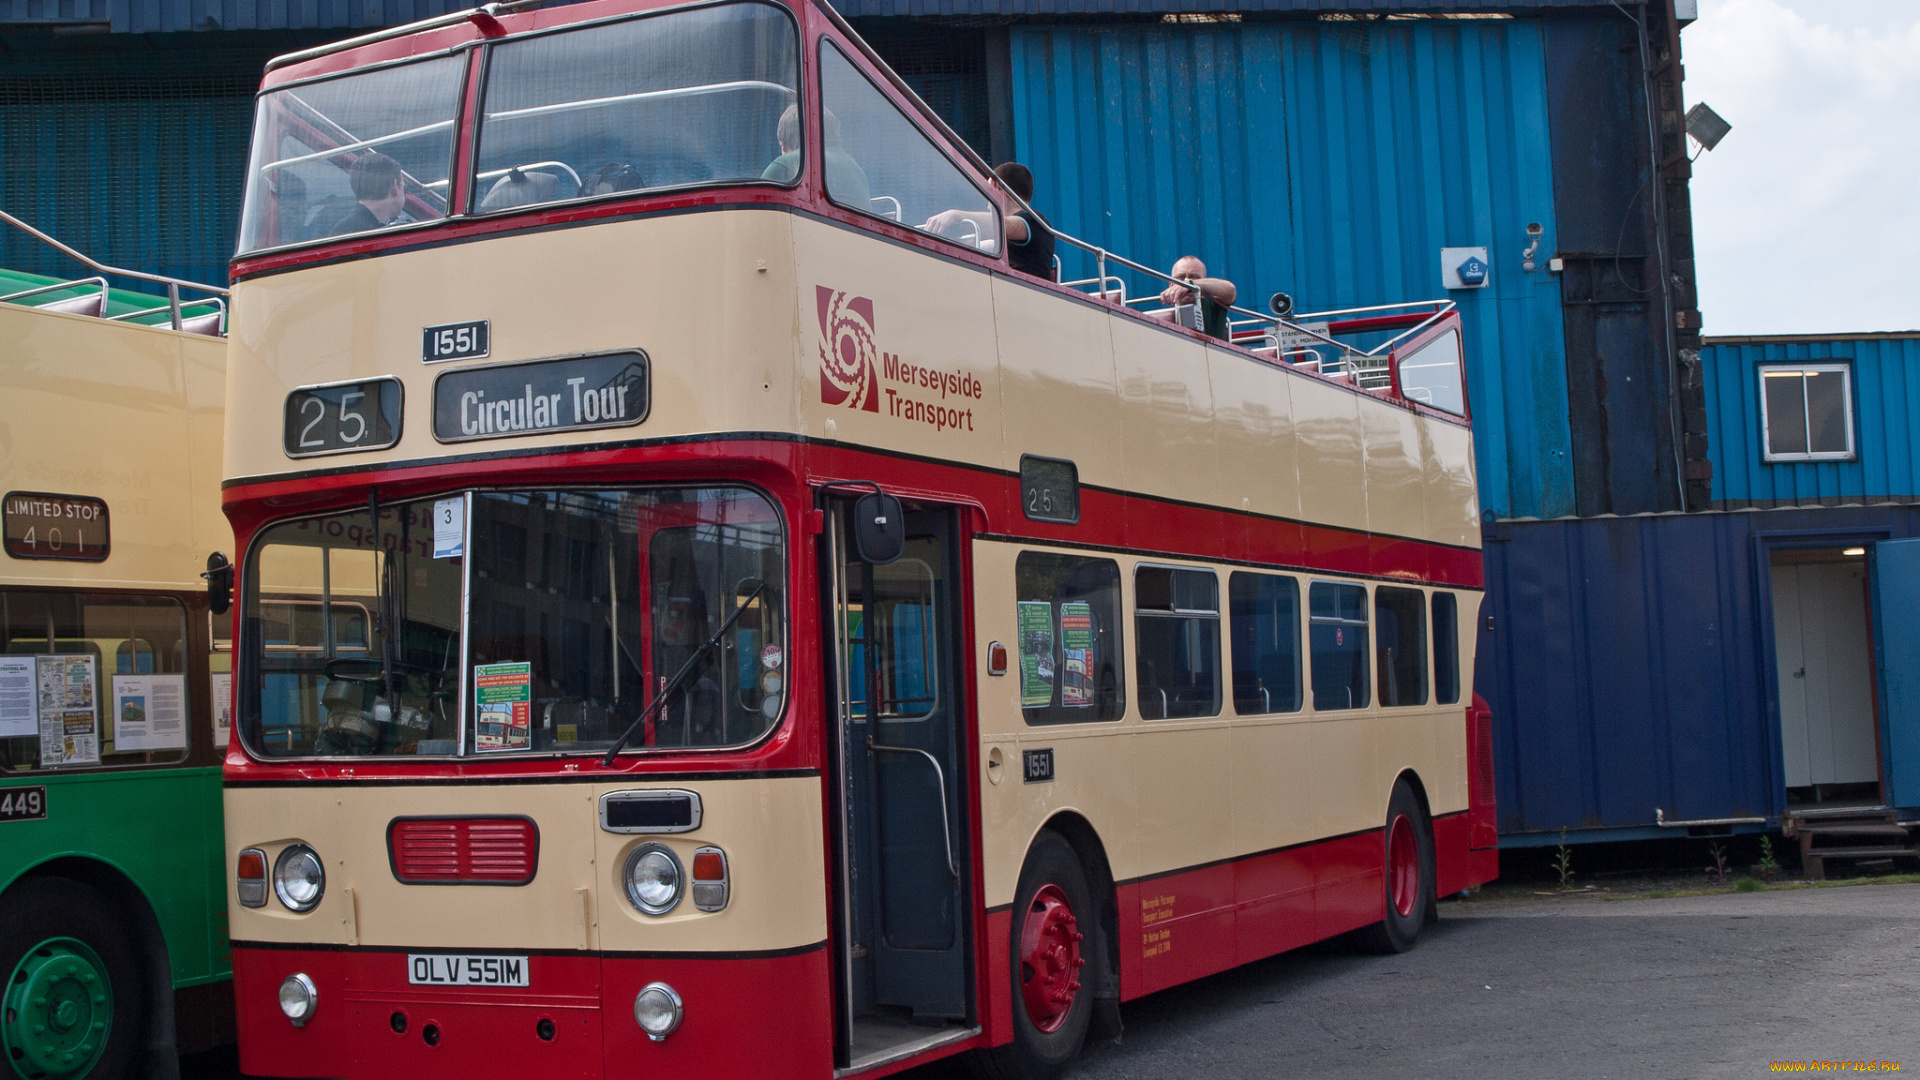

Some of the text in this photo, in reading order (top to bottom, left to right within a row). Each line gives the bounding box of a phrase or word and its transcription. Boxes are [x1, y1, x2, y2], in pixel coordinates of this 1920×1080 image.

[434, 326, 478, 356] 1551
[883, 352, 982, 400] Merseyside
[460, 376, 629, 436] Circular Tour
[885, 388, 974, 432] Transport
[300, 391, 367, 448] 25
[6, 500, 62, 517] LIMITED
[66, 504, 100, 520] STOP
[1029, 488, 1052, 512] 25
[444, 509, 452, 524] 3
[1029, 754, 1050, 777] 1551
[1, 791, 40, 816] 449
[414, 958, 521, 984] OLV 551M
